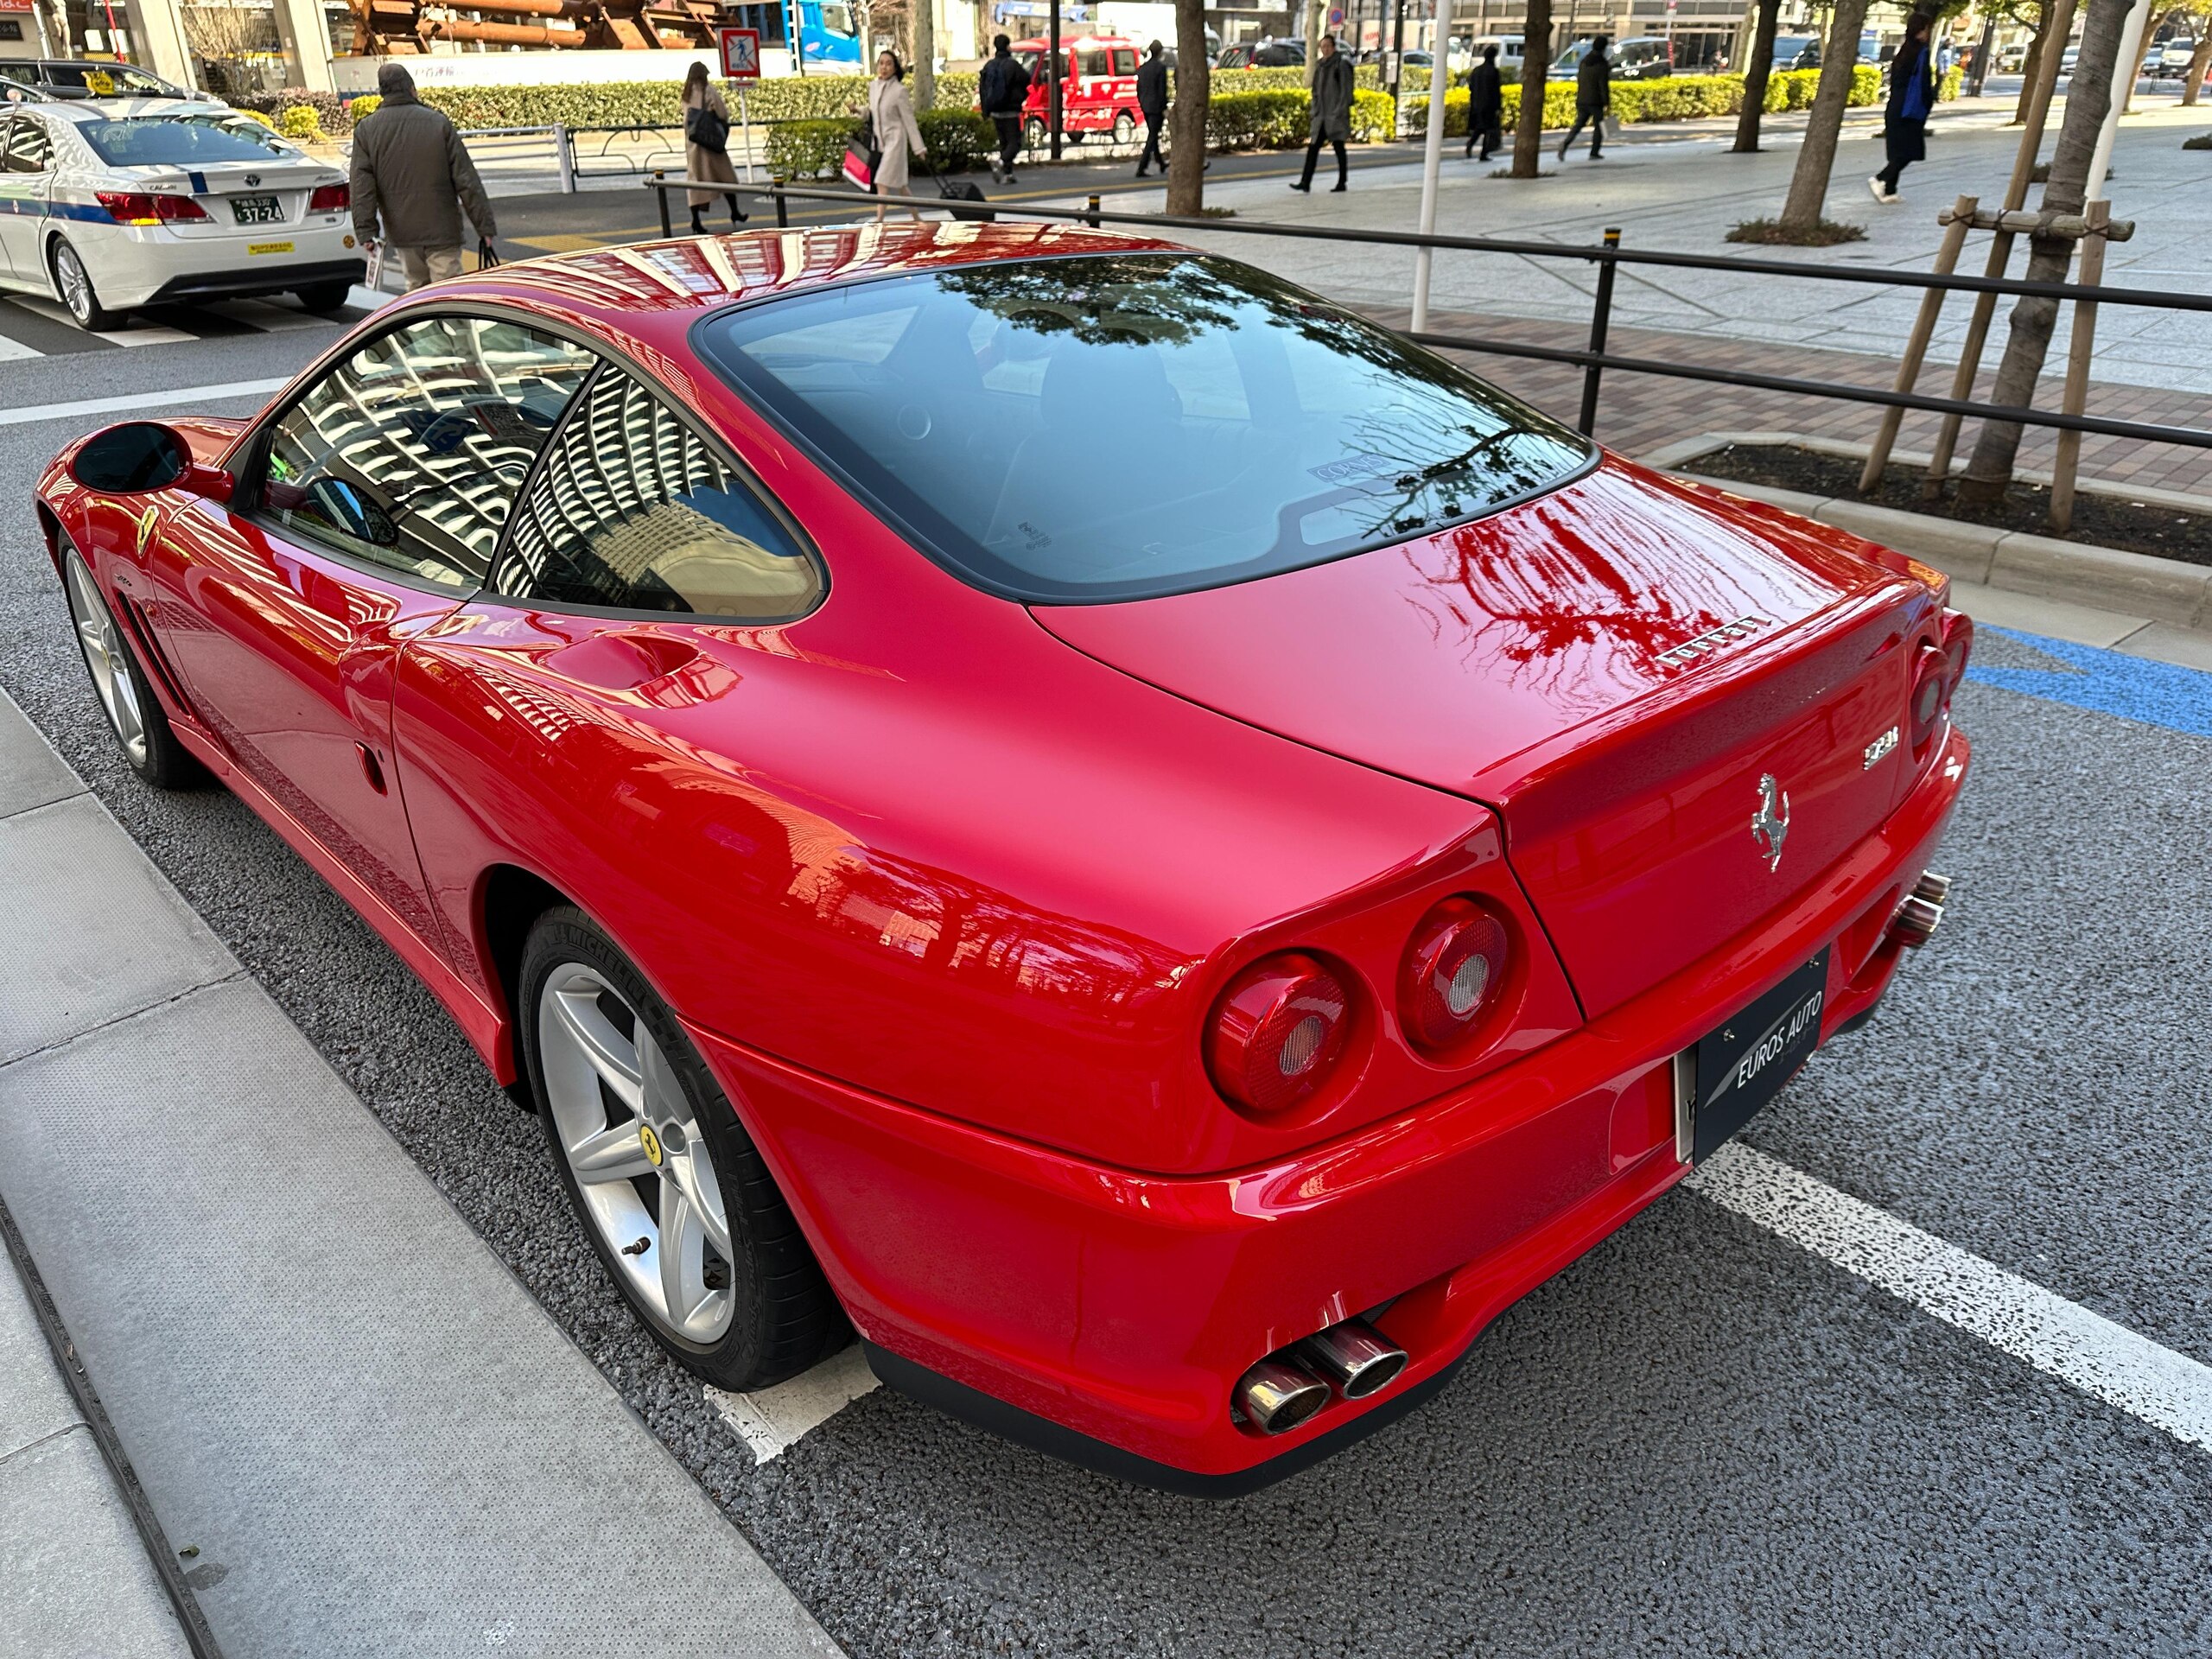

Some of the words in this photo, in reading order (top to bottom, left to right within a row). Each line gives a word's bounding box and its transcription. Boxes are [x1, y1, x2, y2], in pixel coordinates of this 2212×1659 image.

[1316, 454, 1384, 480] CORNES
[1654, 613, 1773, 670] Ferrari
[567, 925, 648, 1011] MICHELIN
[1737, 1025, 1786, 1090] EUROS
[1785, 990, 1822, 1045] AUTO
